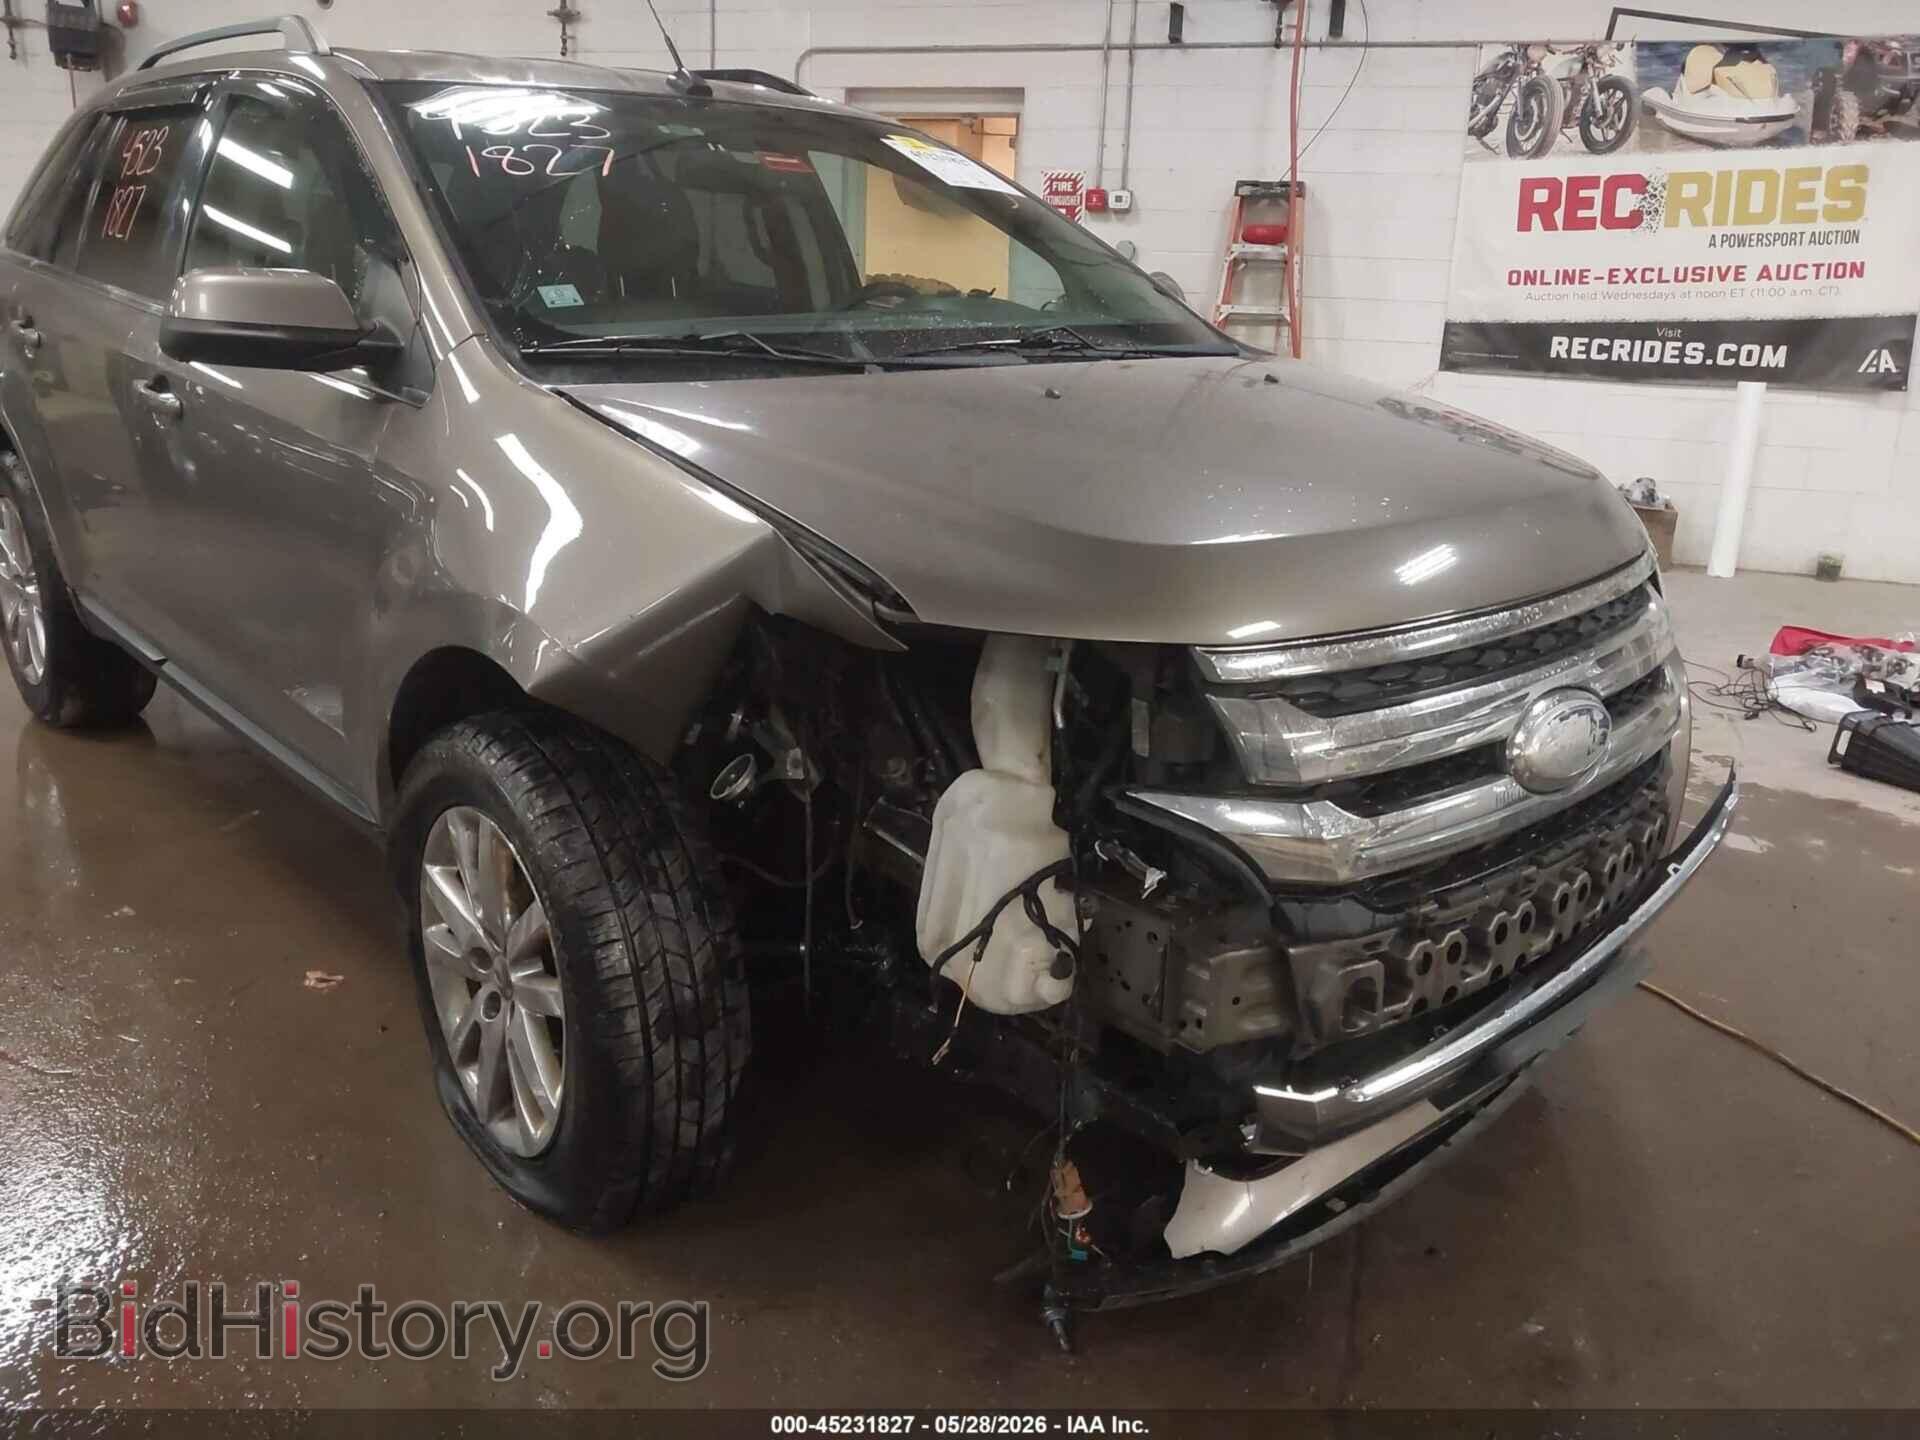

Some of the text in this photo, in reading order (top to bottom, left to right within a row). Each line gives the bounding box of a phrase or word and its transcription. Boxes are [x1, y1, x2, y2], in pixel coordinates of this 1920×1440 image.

[465, 143, 615, 177] 1827
[1051, 181, 1074, 192] FIRE
[1516, 164, 1870, 232] REC RIDES
[1708, 229, 1861, 249] A POWERSPORT AUCTION
[1507, 261, 1866, 286] ONLINE-EXCLUSIVE AUCTION
[1525, 291, 1570, 301] Auction
[1573, 289, 1598, 300] held
[1601, 288, 1676, 301] Wednesdays
[1679, 289, 1692, 299] at
[1696, 289, 1727, 299] noon
[1729, 288, 1746, 298] ET
[1656, 327, 1682, 338] Visit
[1549, 335, 1788, 368] RECRIDES.COM
